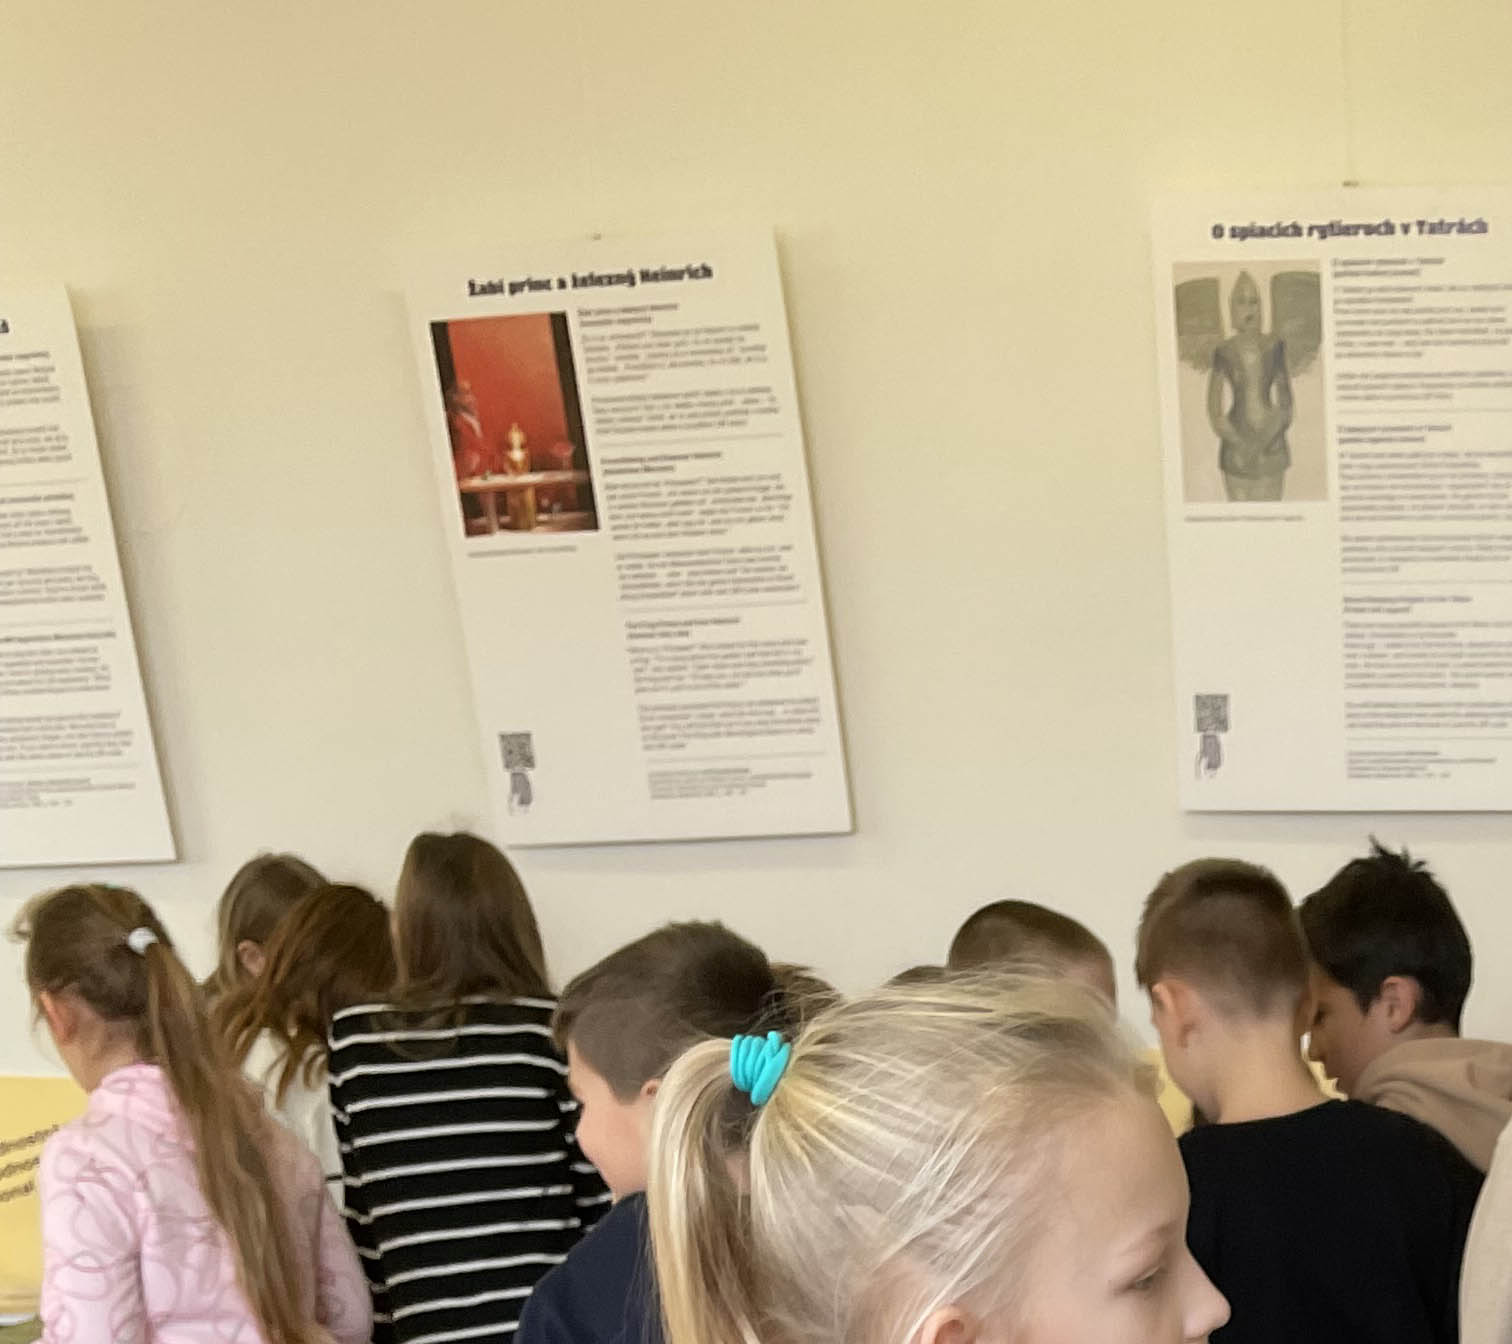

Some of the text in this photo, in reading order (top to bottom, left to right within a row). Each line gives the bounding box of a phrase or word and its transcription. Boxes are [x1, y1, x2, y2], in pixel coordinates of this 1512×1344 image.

[1211, 222, 1224, 240] O
[1400, 221, 1411, 235] v
[639, 263, 713, 283] Heinrich
